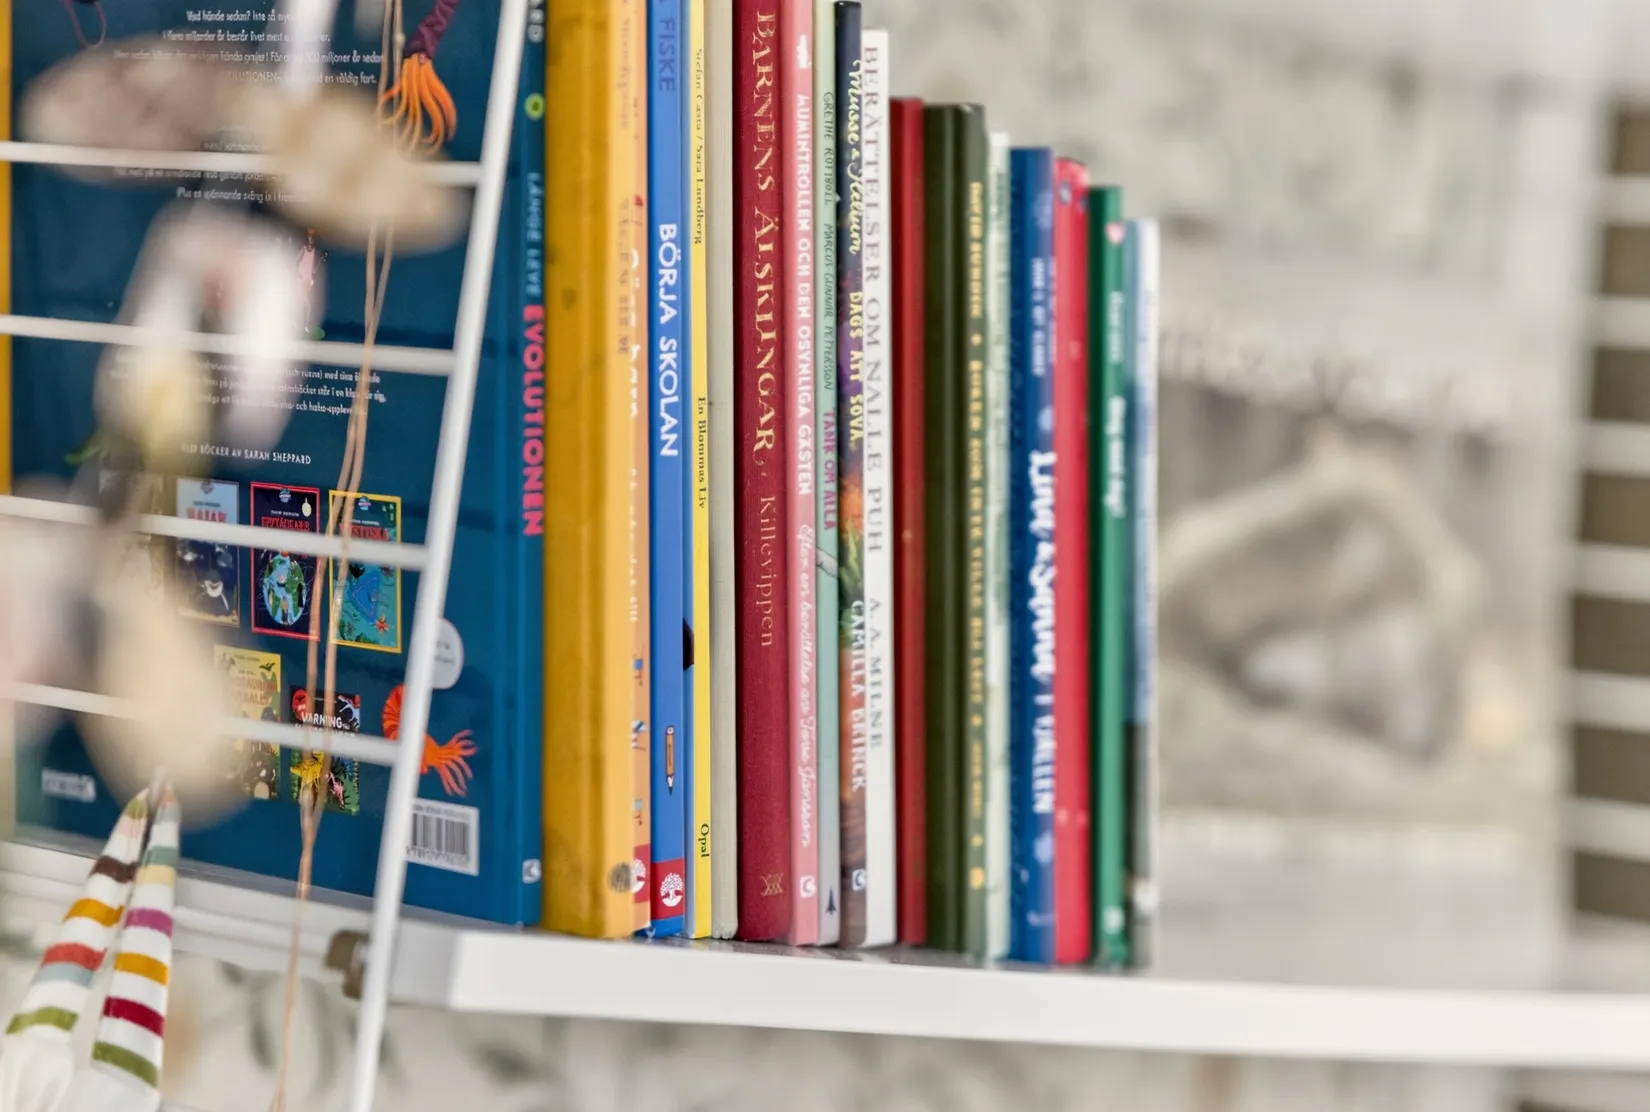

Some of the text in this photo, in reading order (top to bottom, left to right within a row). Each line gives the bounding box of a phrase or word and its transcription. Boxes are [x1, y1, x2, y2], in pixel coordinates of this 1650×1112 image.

[187, 10, 201, 21] Vad
[203, 10, 225, 21] hände
[226, 10, 250, 22] sedan?
[227, 29, 248, 41] består
[250, 30, 265, 41] livet
[321, 52, 351, 63] miljoner
[352, 50, 362, 62] år
[324, 75, 334, 84] en
[359, 71, 378, 84] fart.
[658, 18, 677, 93] FISKE
[695, 48, 704, 89] Stefan
[751, 9, 776, 192] BARNENS
[823, 91, 835, 140] GRETHE
[847, 59, 865, 145] Musse
[696, 144, 704, 173] Sara
[797, 94, 812, 232] MUMINTROLLEN
[203, 188, 242, 200] spännande
[243, 189, 264, 203] sväng
[694, 176, 705, 244] Lundberg
[846, 161, 865, 255] Helium
[797, 236, 812, 276] OCH
[797, 281, 812, 318] DEN
[823, 222, 835, 392] MARCUS GUNNAR PETTERSSON
[863, 45, 883, 553] BERÄTTELSER OM NALLE PUH
[523, 171, 544, 537] LÄNGE LEVE EVOLUTIONEN
[659, 223, 682, 456] BÖRJA SKOLAN
[324, 370, 339, 381] med
[797, 324, 812, 418] OSYNLIGA
[849, 291, 865, 441] DAGS ATT SOVA
[296, 402, 308, 412] och
[199, 443, 230, 457] BÖCKER
[231, 448, 242, 459] AV
[243, 448, 270, 461] SARAH
[272, 452, 312, 466] SHEPPARD
[698, 396, 708, 509] En Blommas Liv
[823, 458, 837, 484] OM
[823, 489, 837, 531] ALLA
[797, 523, 813, 568] Efter
[756, 495, 778, 647] Killevippen
[800, 572, 810, 599] en
[800, 599, 813, 682] berättelse
[850, 600, 867, 792] CAMILLA BRINCK
[869, 656, 883, 749] MILNE
[801, 716, 816, 762] Tove
[797, 765, 816, 848] Jansson
[698, 823, 710, 858] Opal
